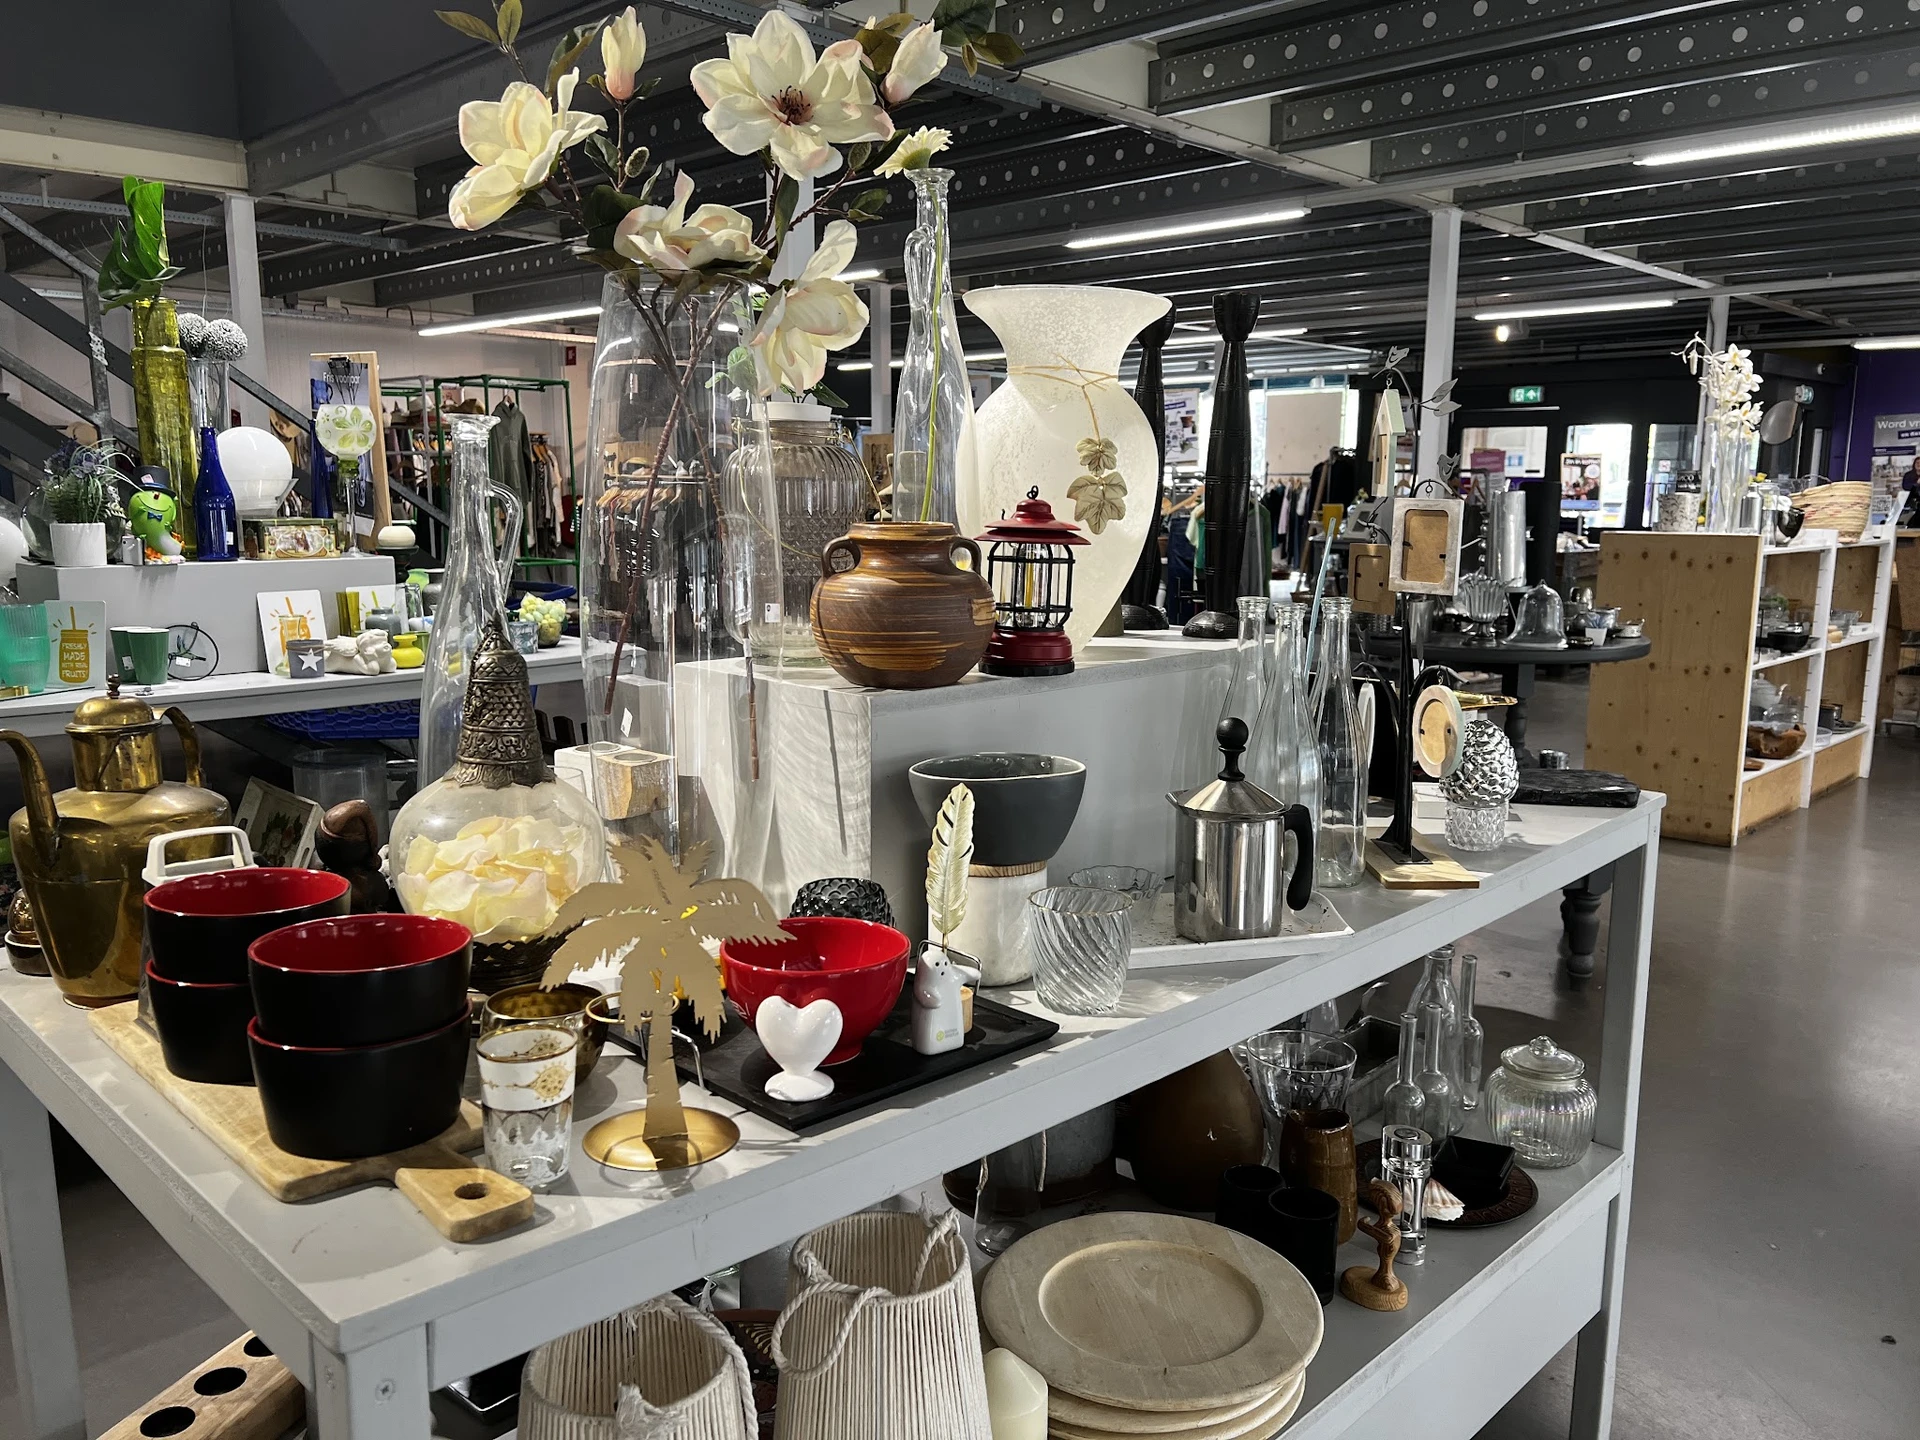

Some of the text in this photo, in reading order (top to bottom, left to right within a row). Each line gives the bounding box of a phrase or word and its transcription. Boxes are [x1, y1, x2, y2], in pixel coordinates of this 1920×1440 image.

[323, 372, 334, 383] Fris
[1878, 420, 1906, 429] Word
[64, 652, 85, 661] MADE
